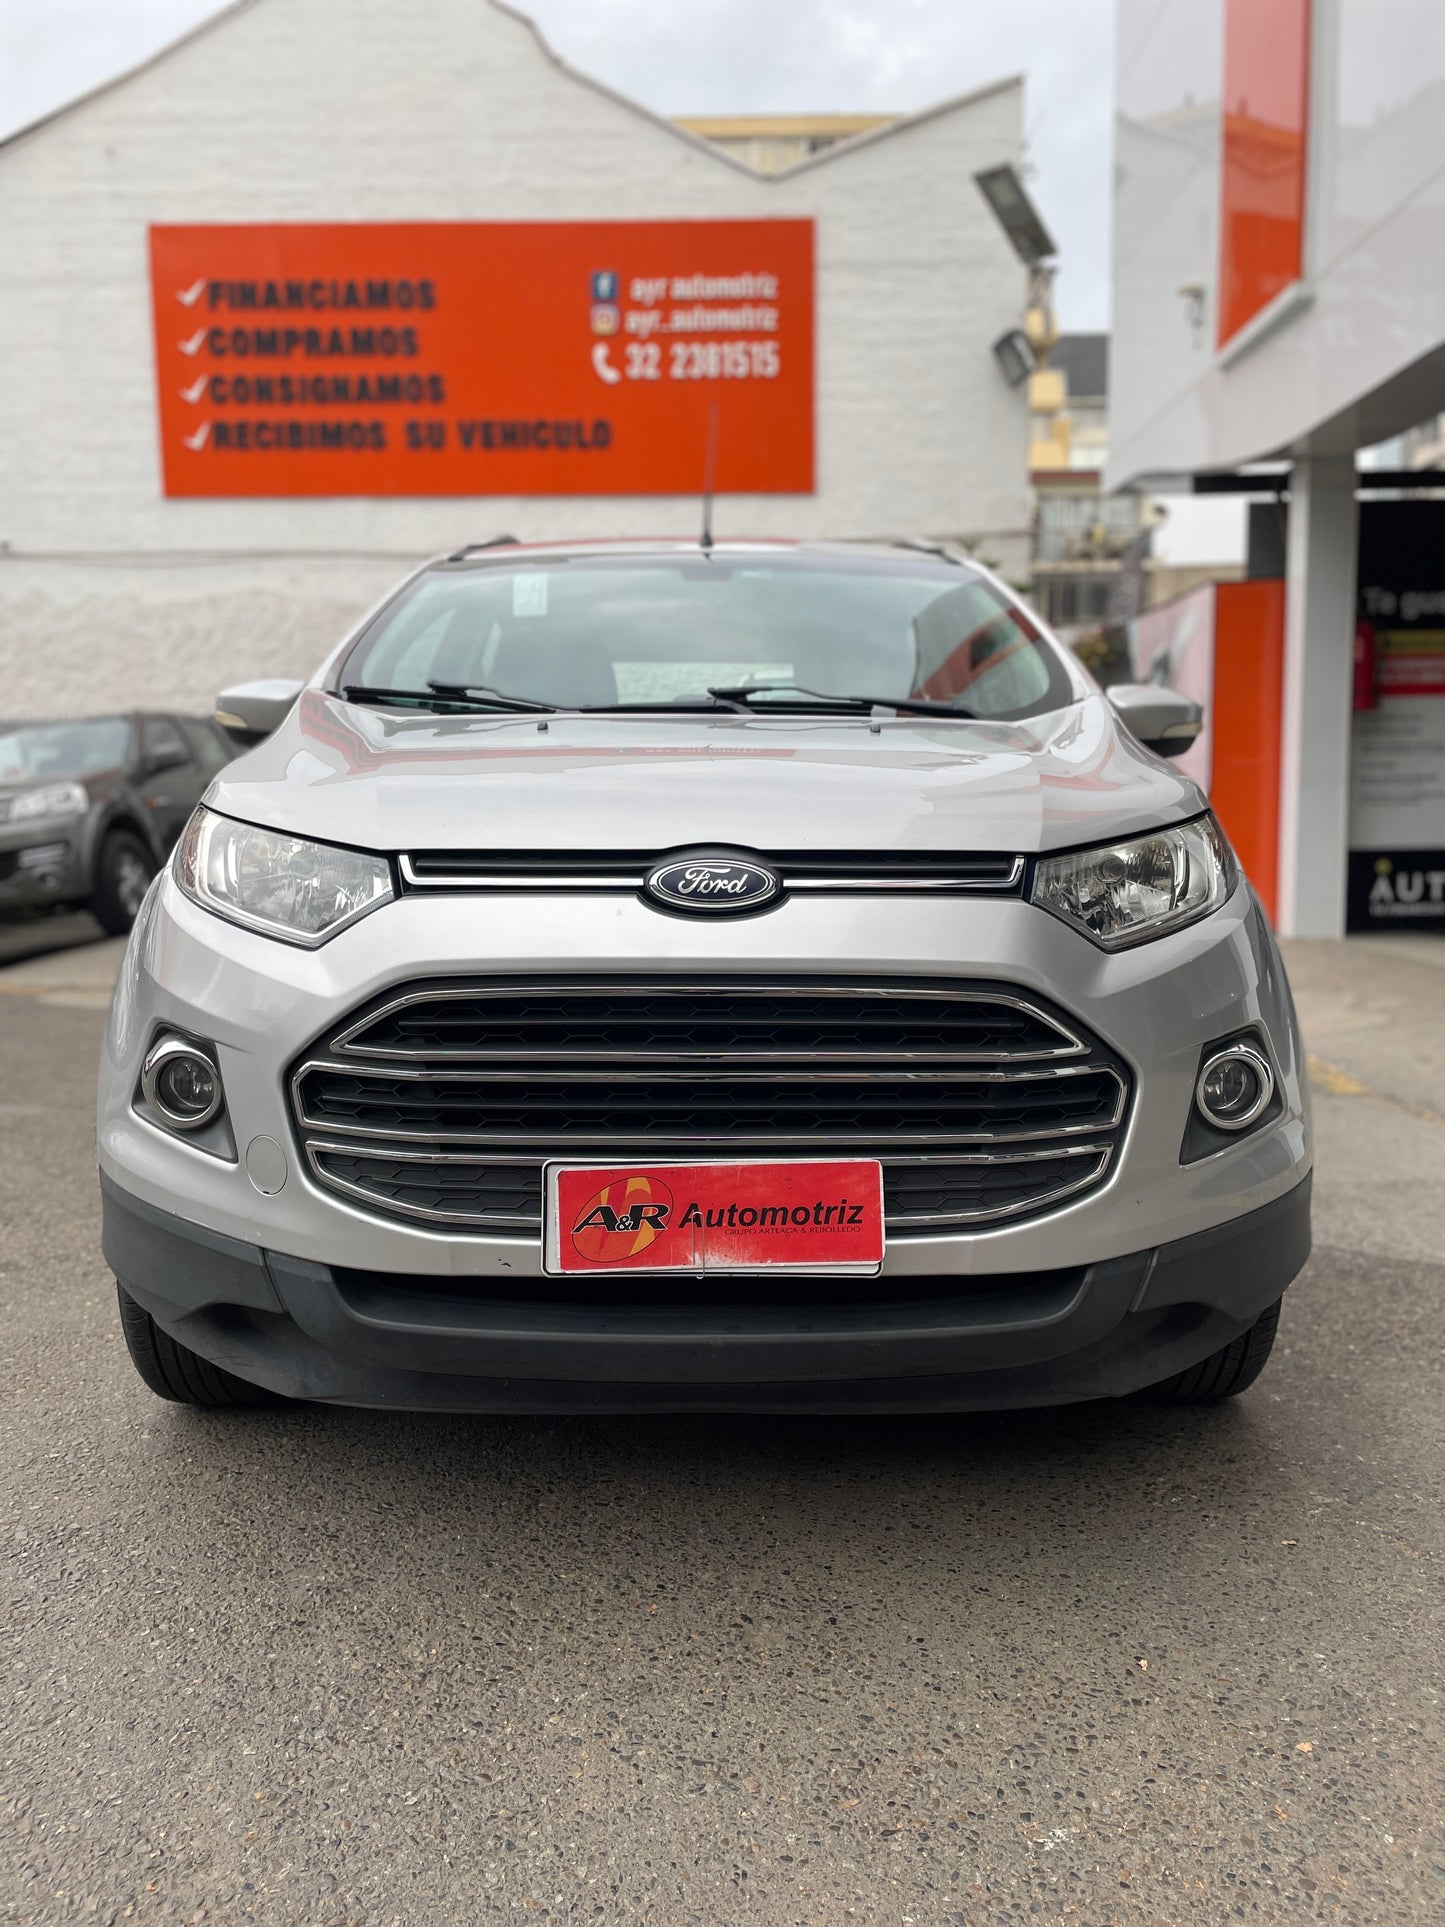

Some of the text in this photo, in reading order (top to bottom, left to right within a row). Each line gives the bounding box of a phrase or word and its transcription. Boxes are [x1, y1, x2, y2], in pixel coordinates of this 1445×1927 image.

[207, 279, 437, 310] FINANCIAMOS
[630, 271, 778, 307] ayr automotriz
[208, 327, 419, 357] COMPRAMOS
[625, 340, 780, 380] 32 2381515
[209, 374, 446, 404] CONSIGNAMOS
[212, 418, 612, 450] RECIBIMOS SU VEHICULO
[678, 867, 748, 894] Ford
[571, 1204, 670, 1234] A&R
[678, 1199, 864, 1229] Automotriz
[724, 1228, 757, 1236] GRUPO
